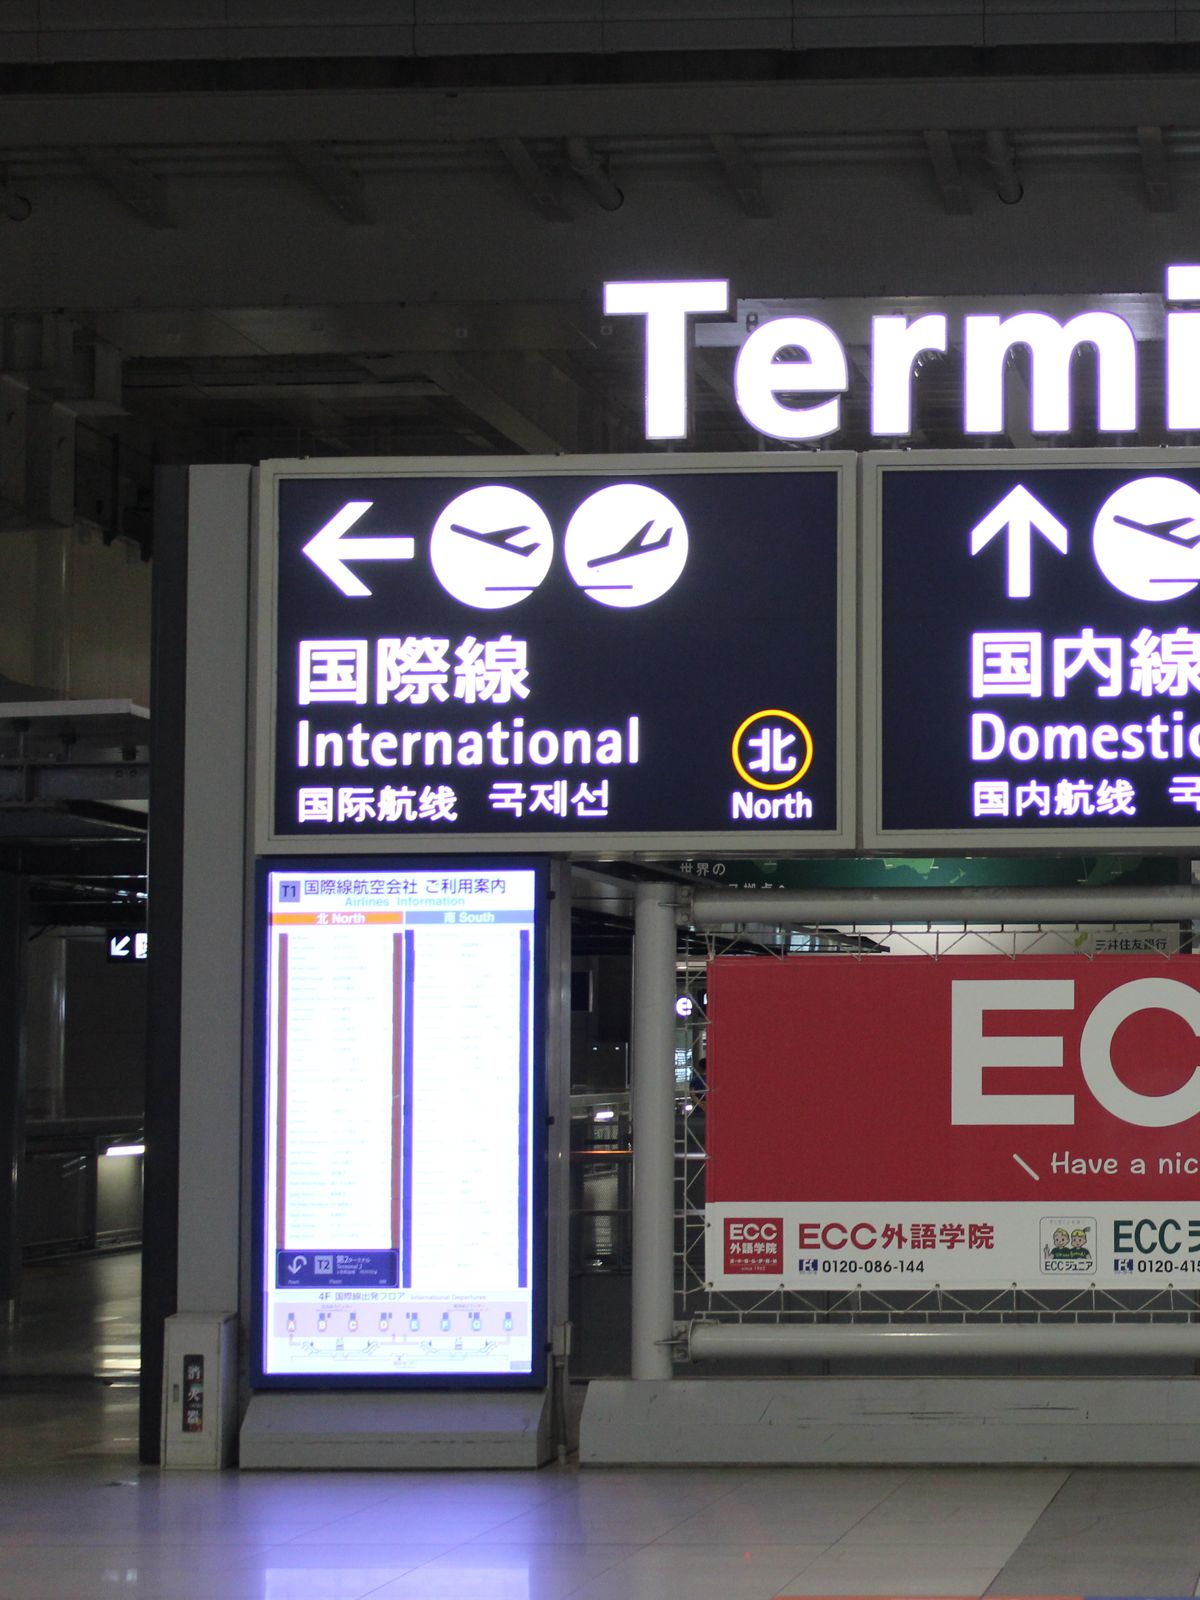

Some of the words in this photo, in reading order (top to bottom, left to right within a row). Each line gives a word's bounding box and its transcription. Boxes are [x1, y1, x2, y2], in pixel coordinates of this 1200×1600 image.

[298, 634, 532, 706] 国際線
[297, 715, 640, 768] International
[747, 727, 797, 773] 北
[297, 784, 459, 824] 国际航线
[488, 779, 610, 818] 국제선
[731, 789, 814, 820] North
[972, 778, 1137, 818] 国内航线
[680, 861, 727, 877] 世界の
[281, 885, 297, 897] T1
[303, 878, 418, 896] 国際線航空会社
[425, 878, 507, 896] ご利用案内
[344, 896, 390, 908] Airlines
[396, 896, 466, 907] Information
[331, 913, 366, 925] North
[458, 911, 495, 924] South
[1095, 938, 1168, 952] 三井住友銀行
[1049, 1151, 1119, 1176] Have
[1129, 1157, 1146, 1176] a
[729, 1222, 778, 1241] ECC
[798, 1221, 995, 1251] ECC外語学院
[729, 1242, 778, 1255] 外語学院
[318, 1259, 331, 1270] T2
[821, 1259, 925, 1274] 0120-086-144
[1044, 1260, 1094, 1271] ECCジュニア
[318, 1292, 331, 1301] 4F
